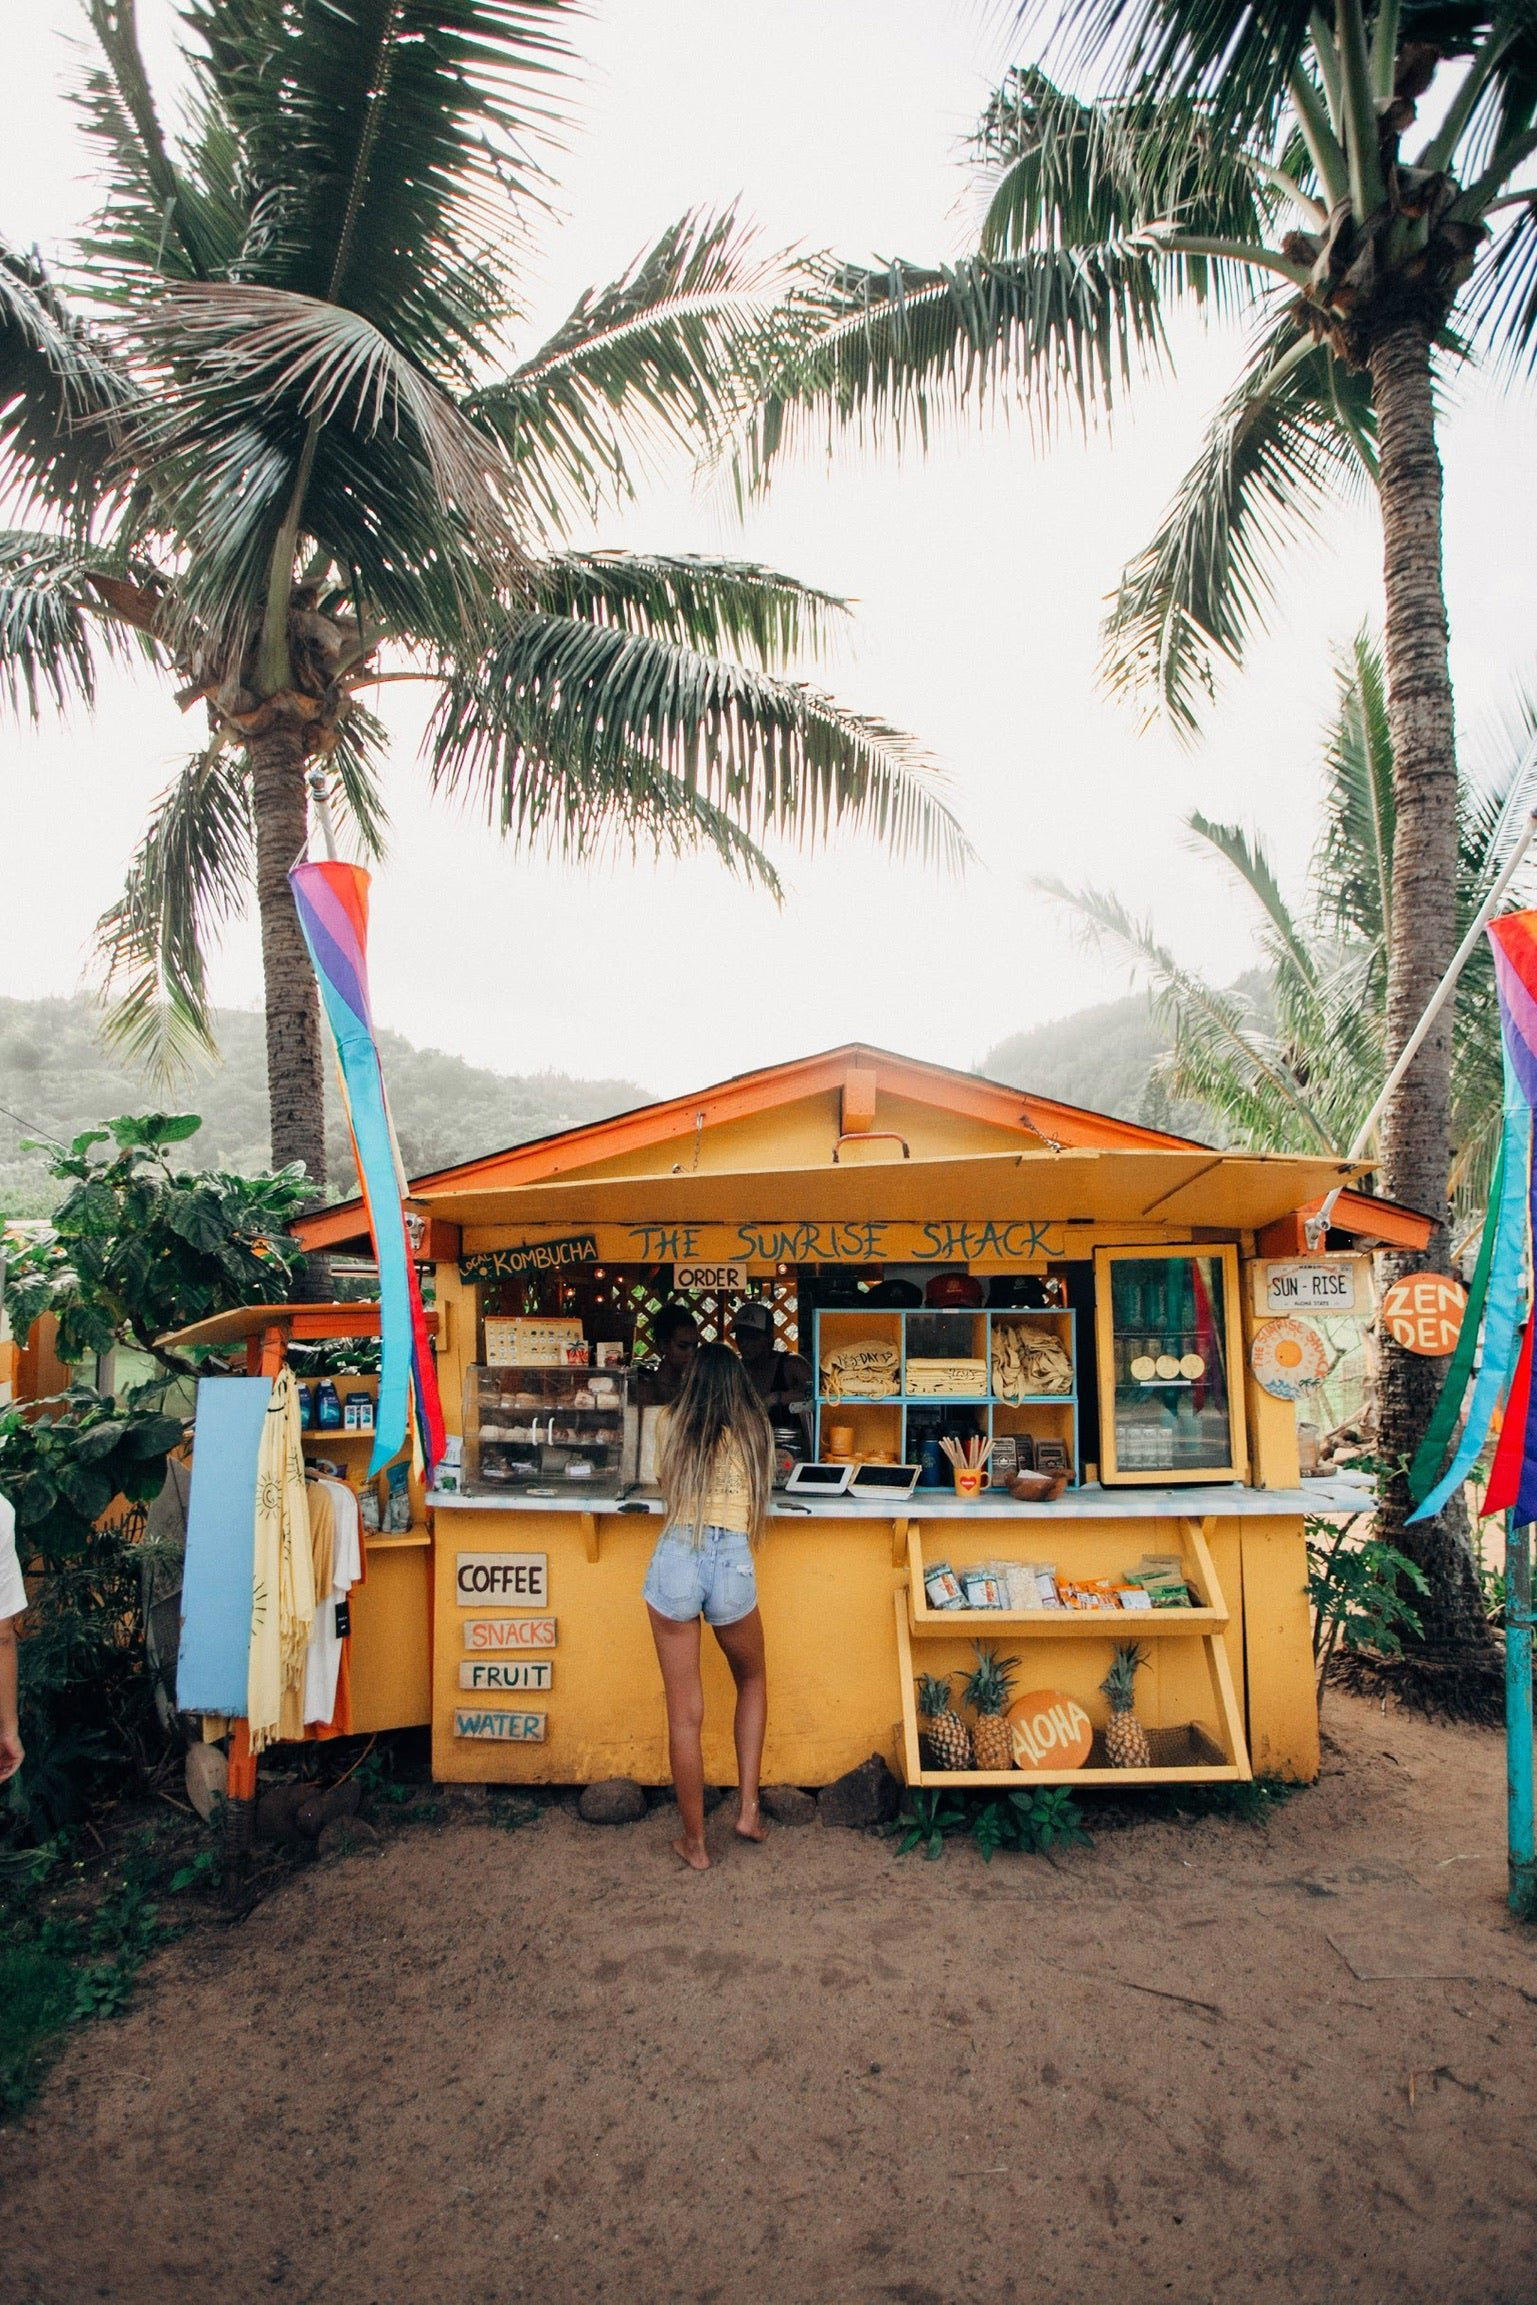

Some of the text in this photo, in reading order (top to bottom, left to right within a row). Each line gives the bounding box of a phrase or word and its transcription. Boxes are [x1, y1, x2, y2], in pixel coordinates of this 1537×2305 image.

[629, 1220, 1065, 1261] THE SUNRISE SHACK
[460, 1240, 597, 1277] LOCAL KOMBUCHA
[678, 1267, 739, 1287] ORDER
[1386, 1282, 1466, 1317] ZEN
[1253, 1319, 1330, 1377] THE SUNRISE SHACK
[1393, 1317, 1460, 1349] DEN
[457, 1564, 543, 1595] COFFEE
[472, 1621, 555, 1649] SNACKS
[472, 1666, 549, 1688] FRUIT
[456, 1713, 542, 1741] WATER
[1010, 1701, 1092, 1767] ALOHA
